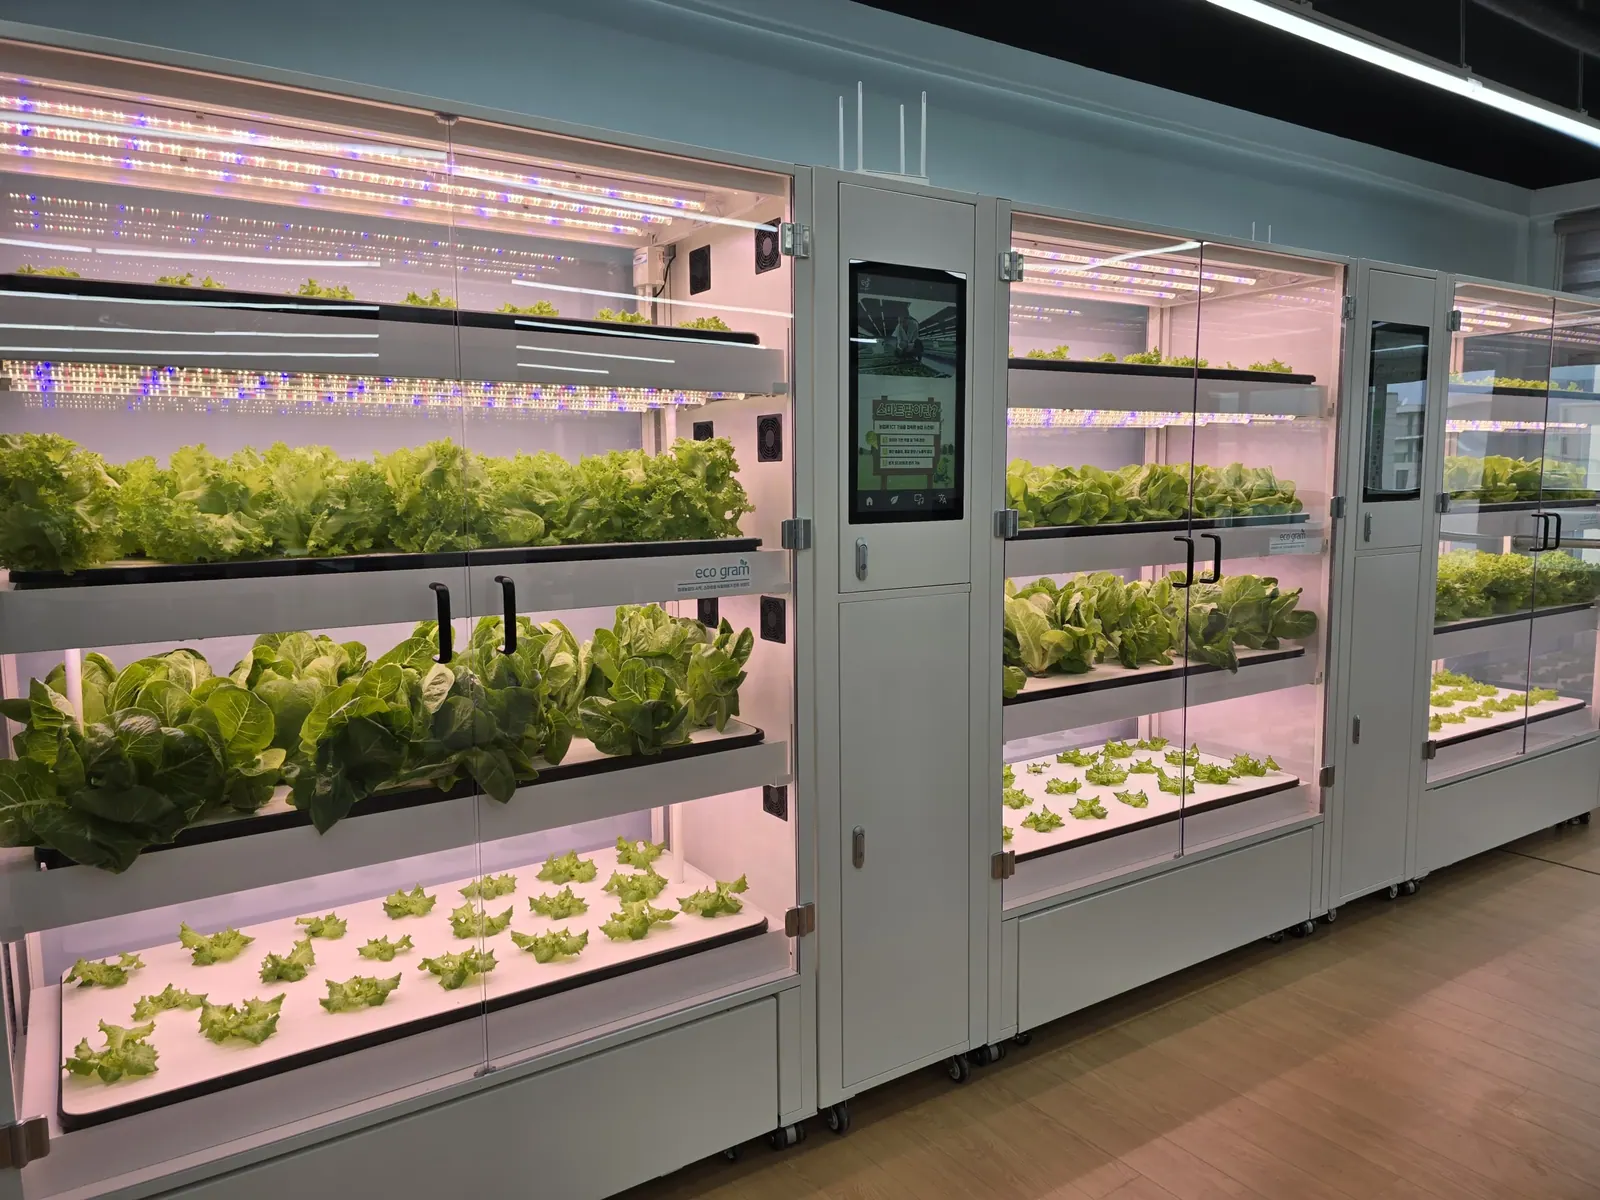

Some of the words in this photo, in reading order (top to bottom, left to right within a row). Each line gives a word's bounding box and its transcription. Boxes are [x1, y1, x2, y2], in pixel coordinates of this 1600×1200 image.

[876, 403, 938, 418] 스마트팜이란?
[1280, 533, 1290, 541] eco
[1291, 531, 1306, 543] gram
[695, 567, 717, 579] eco
[720, 564, 750, 580] gram
